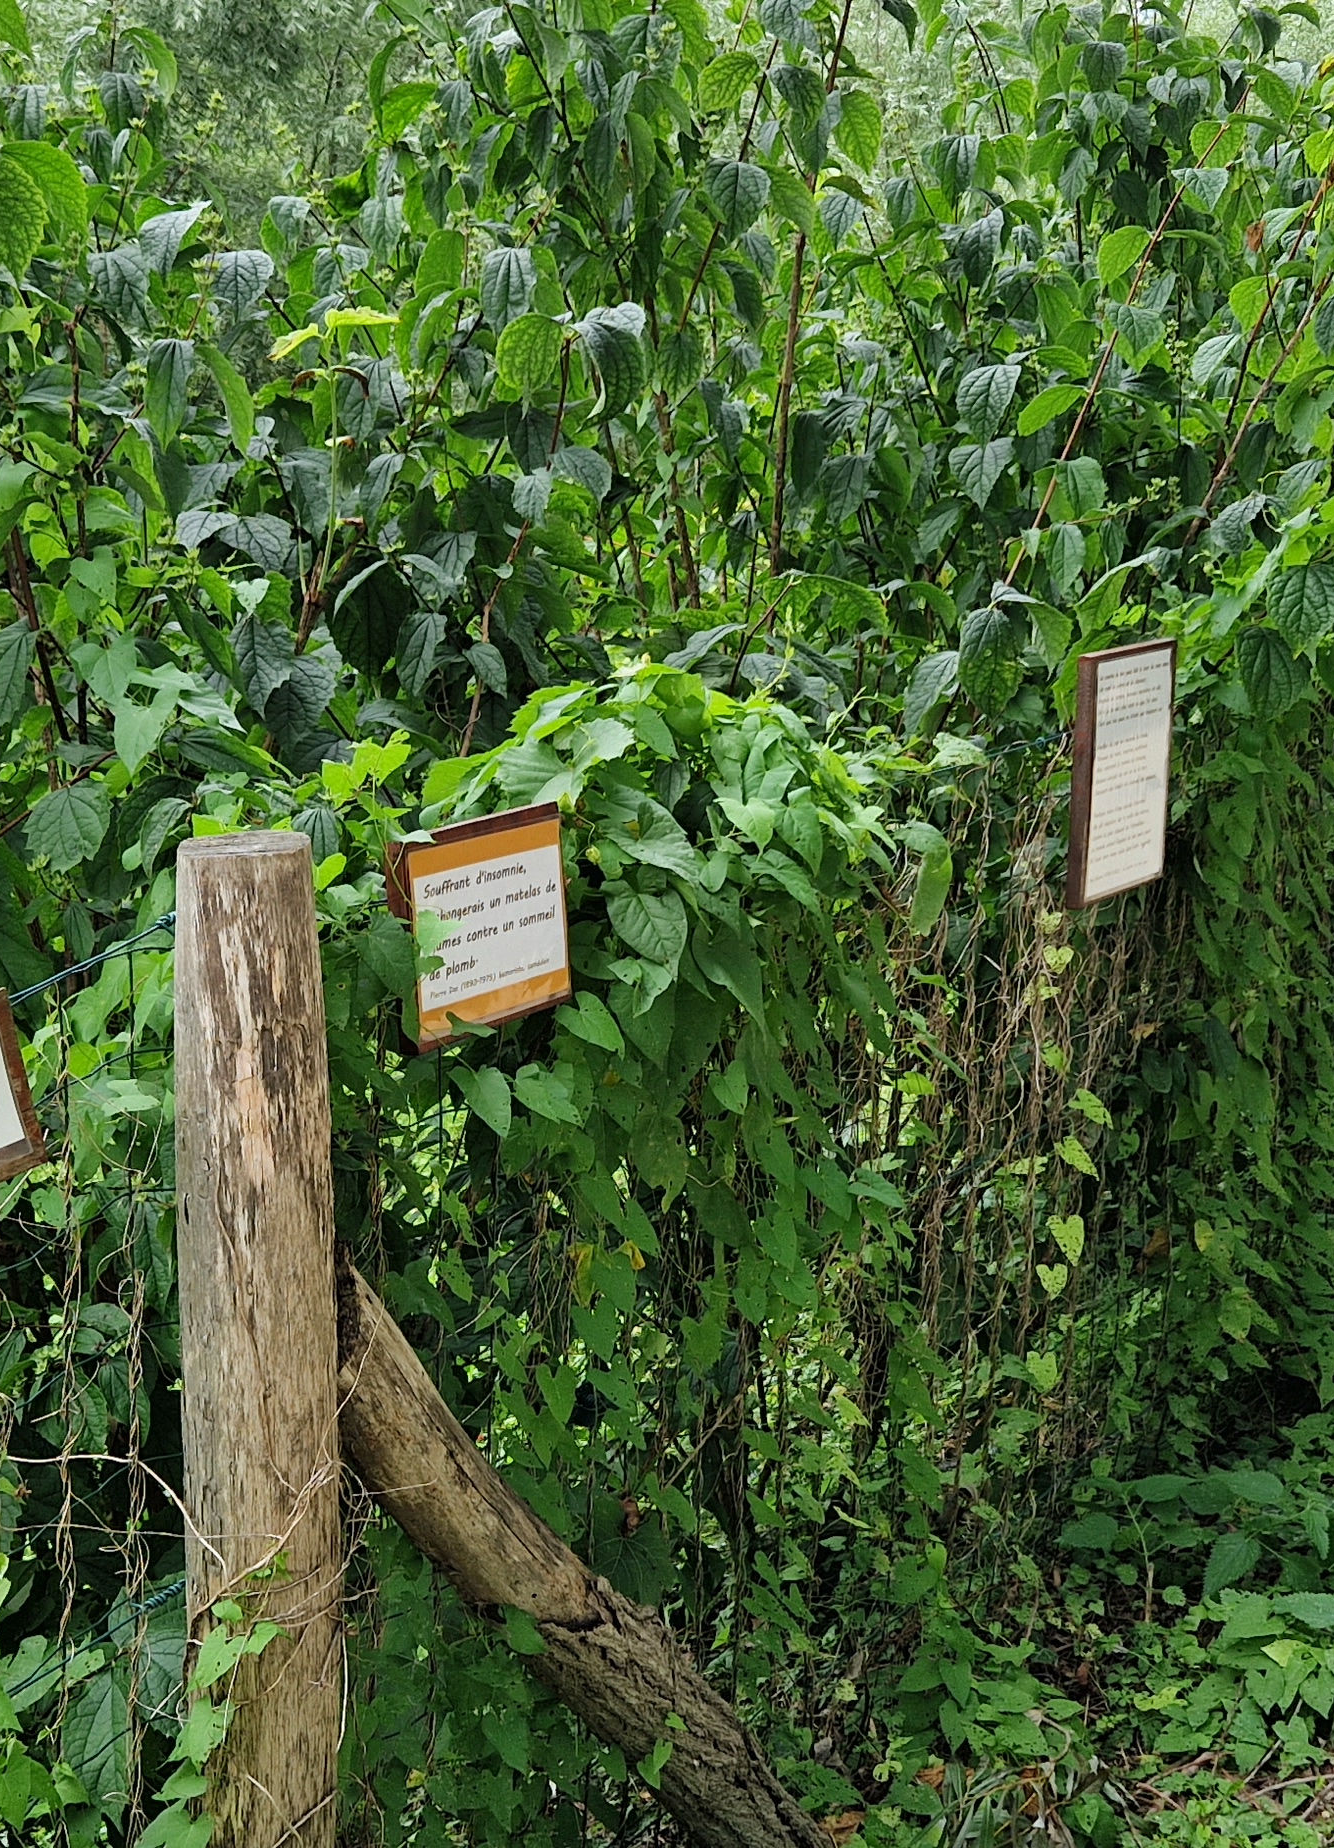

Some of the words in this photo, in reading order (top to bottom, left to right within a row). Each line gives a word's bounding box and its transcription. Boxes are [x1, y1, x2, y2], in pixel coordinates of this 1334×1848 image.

[424, 876, 471, 899] Souffrant
[476, 862, 527, 885] d'insomnie,
[437, 900, 485, 921] hangerais
[489, 897, 501, 909] un
[505, 884, 541, 904] matelas
[545, 879, 557, 894] de
[434, 935, 462, 951] umes
[466, 926, 498, 943] contre
[502, 920, 514, 933] un
[519, 905, 555, 927] sommeil
